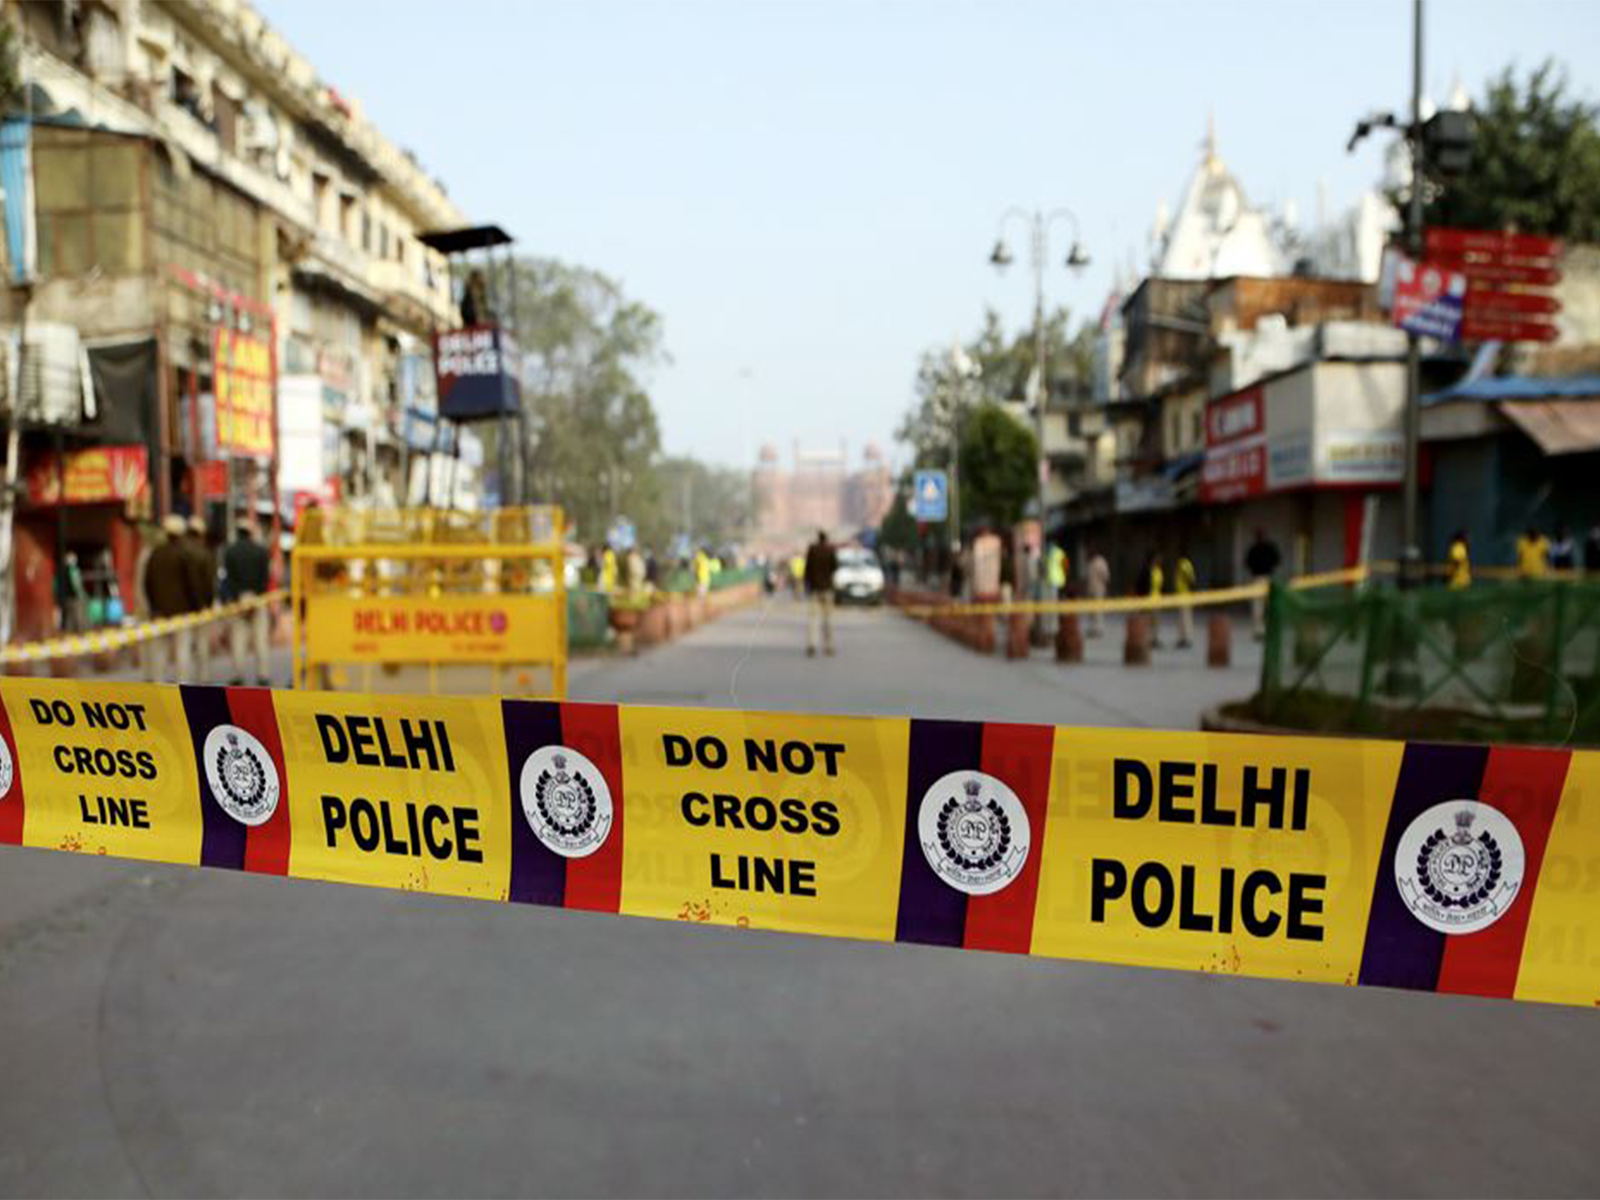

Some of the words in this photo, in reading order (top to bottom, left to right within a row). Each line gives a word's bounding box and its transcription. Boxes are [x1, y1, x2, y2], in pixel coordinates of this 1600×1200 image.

[29, 698, 76, 727] DO
[81, 701, 146, 731] NOT
[53, 745, 157, 780] CROSS
[314, 713, 456, 772] DELHI
[662, 734, 728, 769] DO
[743, 738, 846, 777] NOT
[78, 794, 151, 829] LINE
[681, 792, 841, 836] CROSS
[1113, 758, 1311, 831] DELHI
[320, 795, 483, 864] POLICE
[710, 853, 817, 897] LINE
[1091, 858, 1327, 942] POLICE
